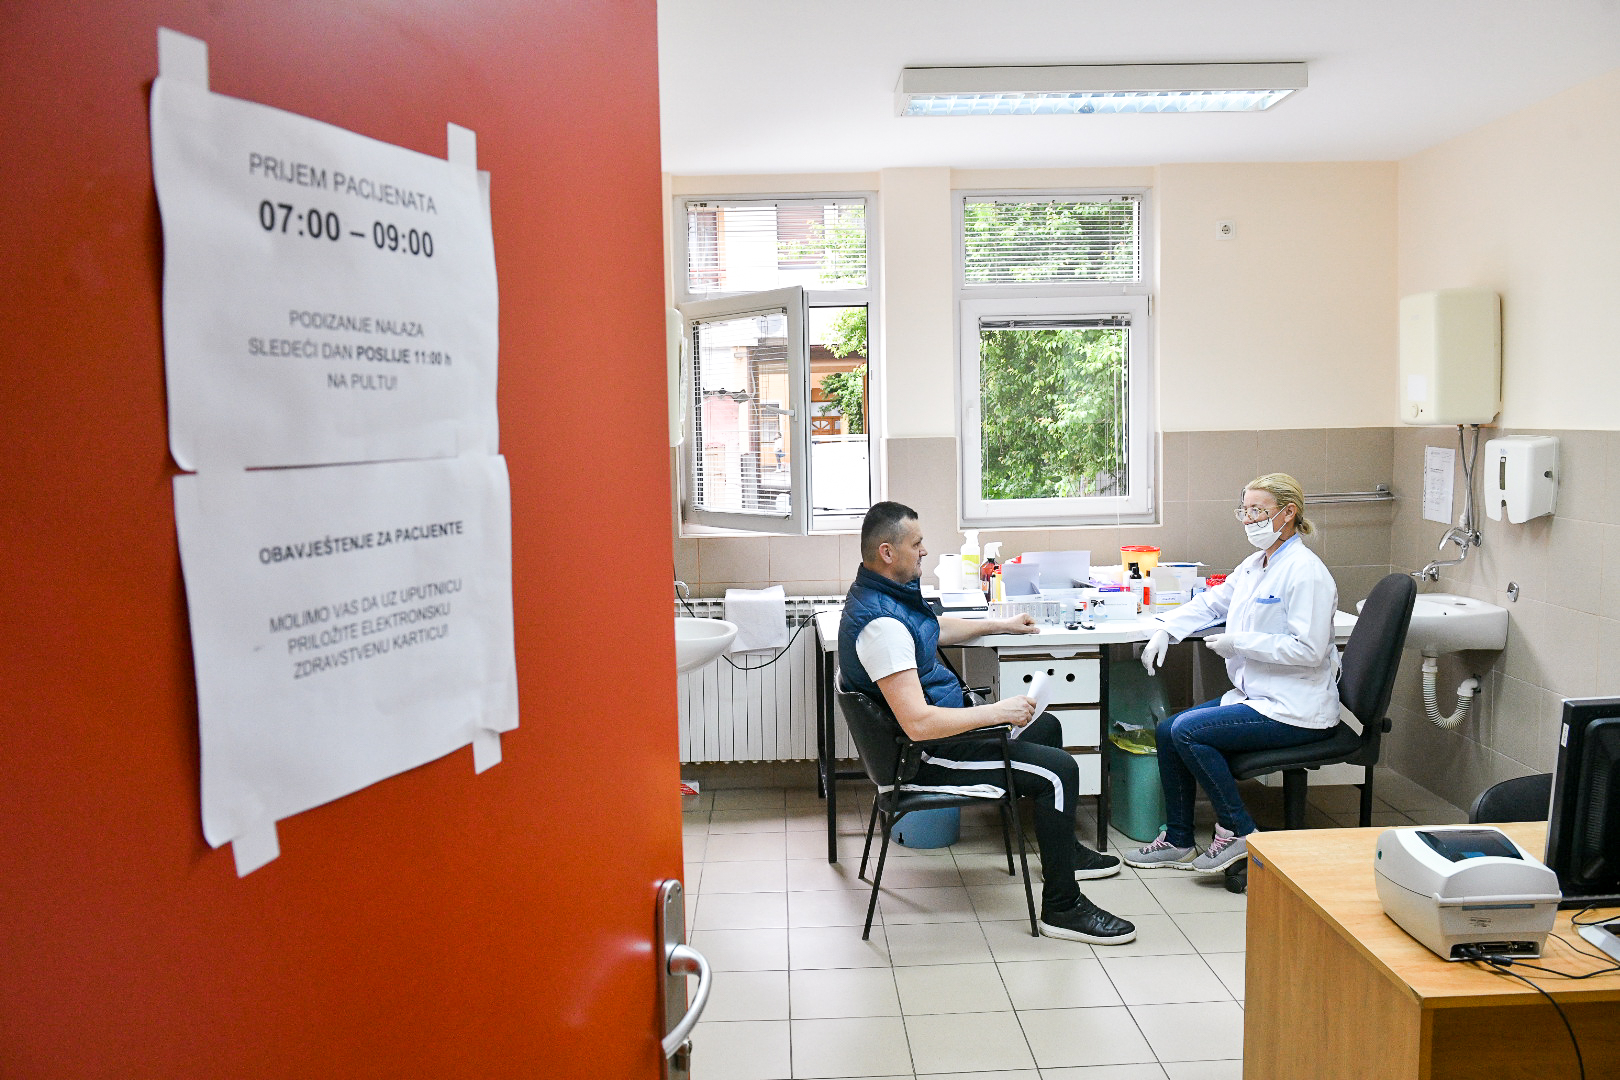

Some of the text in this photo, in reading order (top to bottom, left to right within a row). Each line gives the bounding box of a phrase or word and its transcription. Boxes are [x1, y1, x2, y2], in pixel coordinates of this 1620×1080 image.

[250, 152, 437, 215] PRIJEM PACIJENATA
[259, 200, 340, 241] 07:00
[373, 222, 433, 258] 09:00
[289, 310, 424, 338] PODIZANJE NALAZA
[248, 337, 318, 358] SLEDEĆI
[321, 342, 352, 359] DAN
[356, 347, 410, 364] POSLIJE
[414, 351, 442, 365] 11:00
[328, 374, 397, 391] NA PULTU!
[259, 521, 463, 564] OBAVJEŠTENJE ZA PACIJENTE
[270, 578, 462, 633] MOLIMO VAS DA UZ UPUTNICU
[288, 602, 451, 654] PRILOŽITE ELEKTRONSKU
[294, 623, 449, 679] ZDRAVSTVENU KARTICU!
